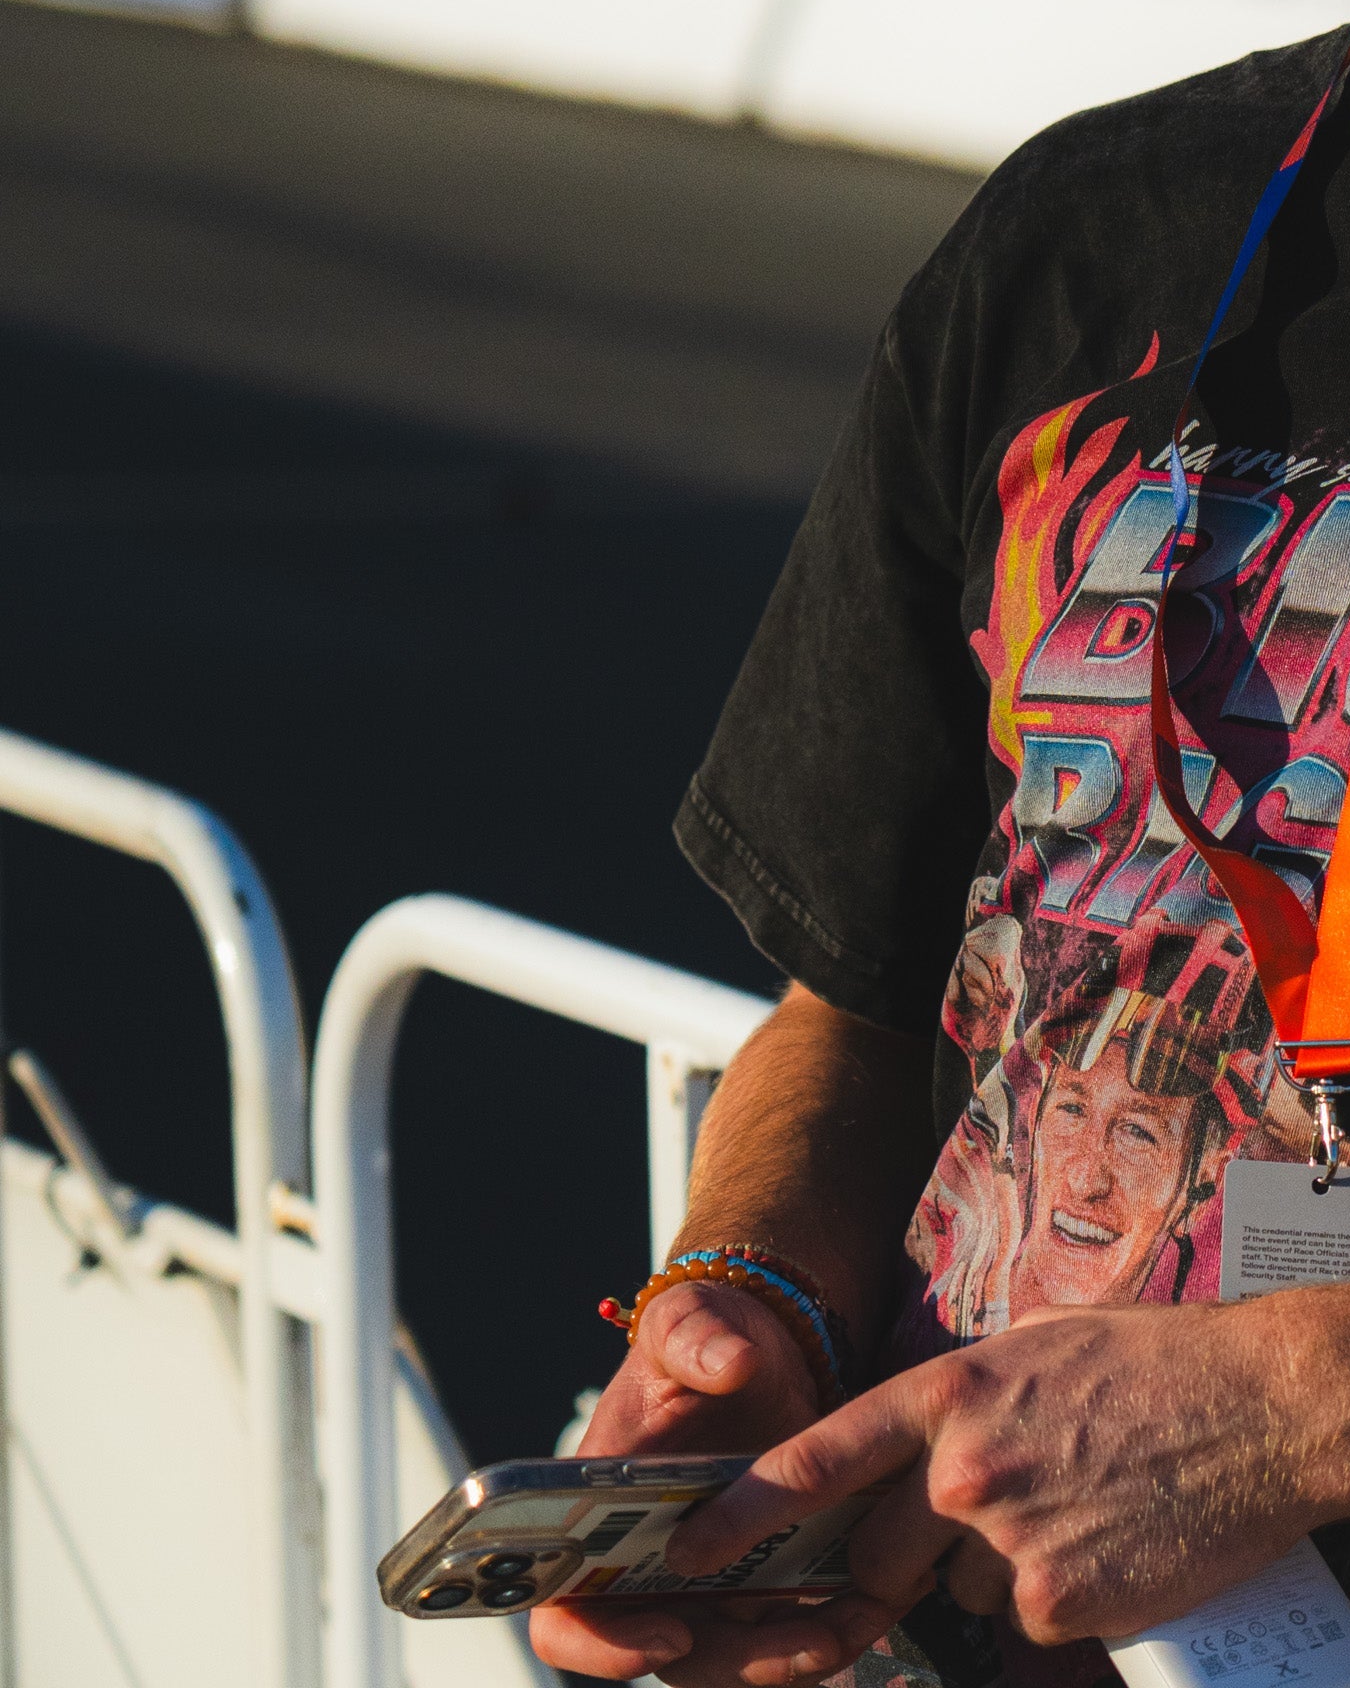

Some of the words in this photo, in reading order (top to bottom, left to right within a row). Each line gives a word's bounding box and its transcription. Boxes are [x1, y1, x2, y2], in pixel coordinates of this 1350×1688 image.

[1242, 1225, 1260, 1233] This
[1262, 1227, 1303, 1236] credential
[1304, 1230, 1336, 1239] remains
[1337, 1232, 1350, 1240] the
[1252, 1235, 1266, 1243] the
[1267, 1237, 1290, 1245] event
[1291, 1238, 1307, 1246] and
[1325, 1240, 1335, 1248] be
[1241, 1244, 1282, 1253] discretion
[1294, 1247, 1314, 1256] Race
[1316, 1248, 1349, 1258] Officials
[1241, 1253, 1262, 1261] staff.
[1264, 1253, 1279, 1262] The
[1280, 1256, 1308, 1264] wearer
[1310, 1258, 1330, 1266] must
[1332, 1259, 1341, 1267] at
[1240, 1270, 1274, 1281] Security
[1276, 1273, 1298, 1281] Staff.
[1241, 1261, 1266, 1270] follow
[1267, 1263, 1307, 1273] directions
[1319, 1267, 1340, 1276] Race
